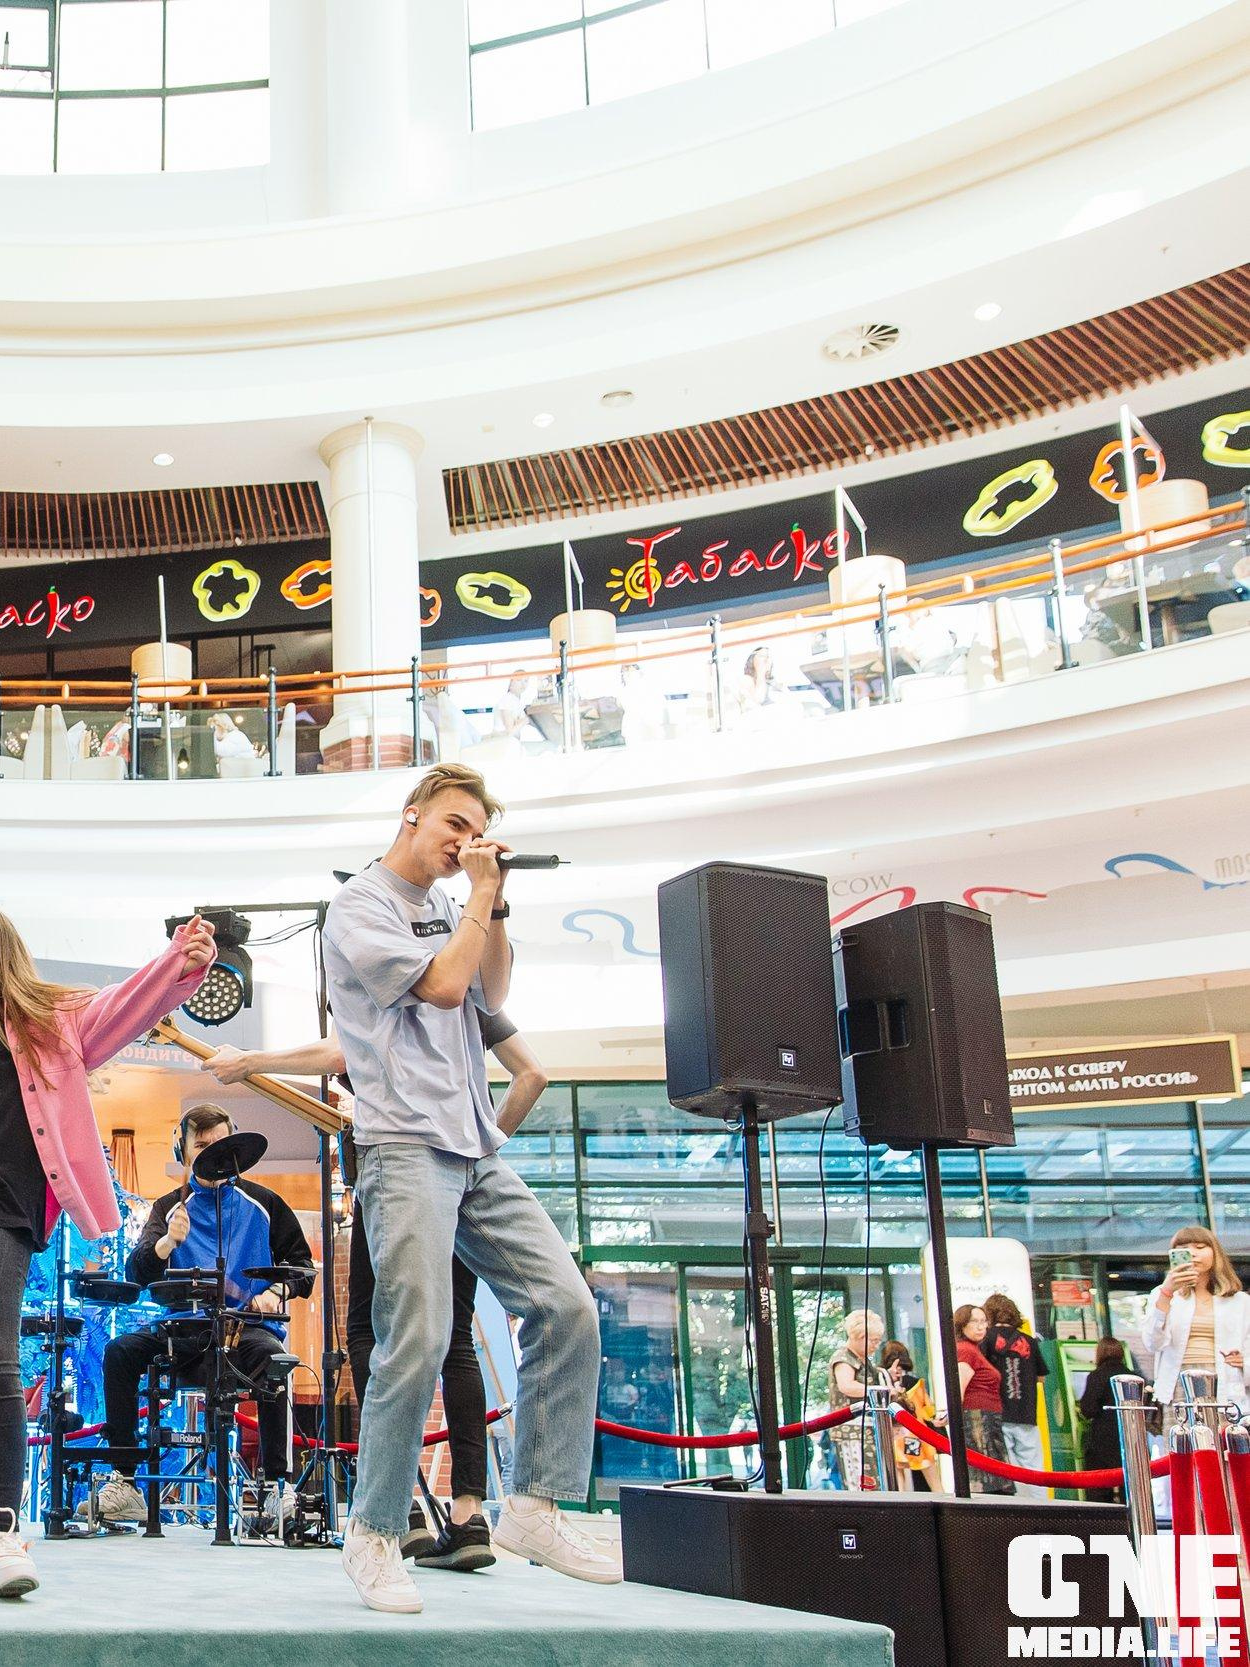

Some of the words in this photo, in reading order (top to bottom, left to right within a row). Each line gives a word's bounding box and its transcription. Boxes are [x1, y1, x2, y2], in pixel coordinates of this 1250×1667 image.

[626, 526, 851, 607] Табаско
[831, 873, 893, 897] COW
[1008, 1066, 1052, 1081] ЫХОД
[1054, 1065, 1066, 1077] К
[1068, 1060, 1127, 1077] СКВЕРУ
[1009, 1081, 1065, 1097] ЕНТОМ
[1068, 1077, 1120, 1092] «МАТЬ
[1122, 1071, 1198, 1089] РОССИЯ»
[180, 1433, 202, 1443] Roland
